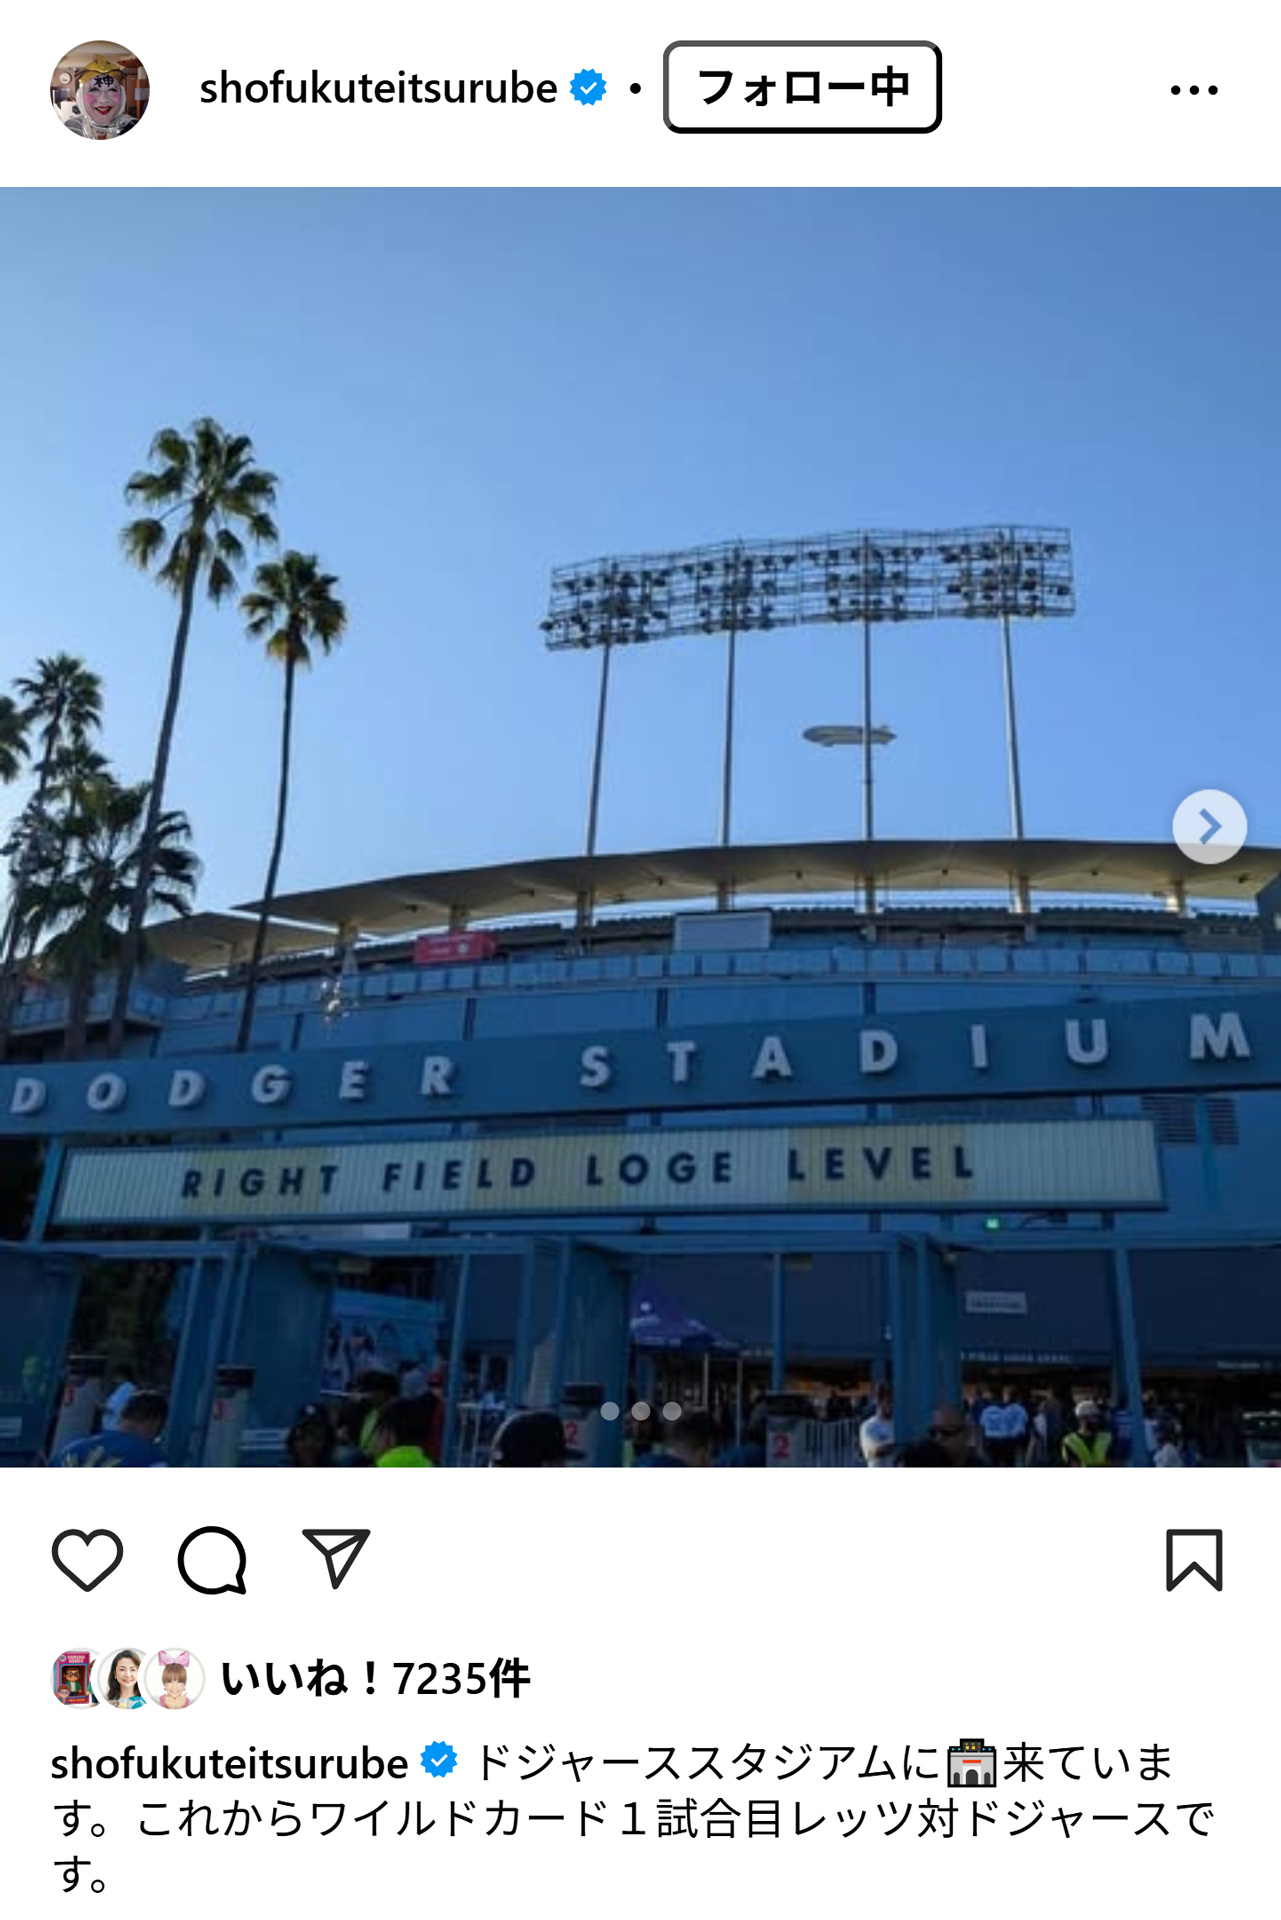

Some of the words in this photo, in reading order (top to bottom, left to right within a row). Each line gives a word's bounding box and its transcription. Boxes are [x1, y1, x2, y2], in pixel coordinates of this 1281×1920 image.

[10, 1055, 456, 1115] DODGER
[580, 1012, 1252, 1089] STADIUM
[181, 1165, 340, 1198] RIGHT
[382, 1157, 537, 1192] FIELD
[587, 1151, 733, 1186] LOGE
[787, 1145, 974, 1181] LEVEL
